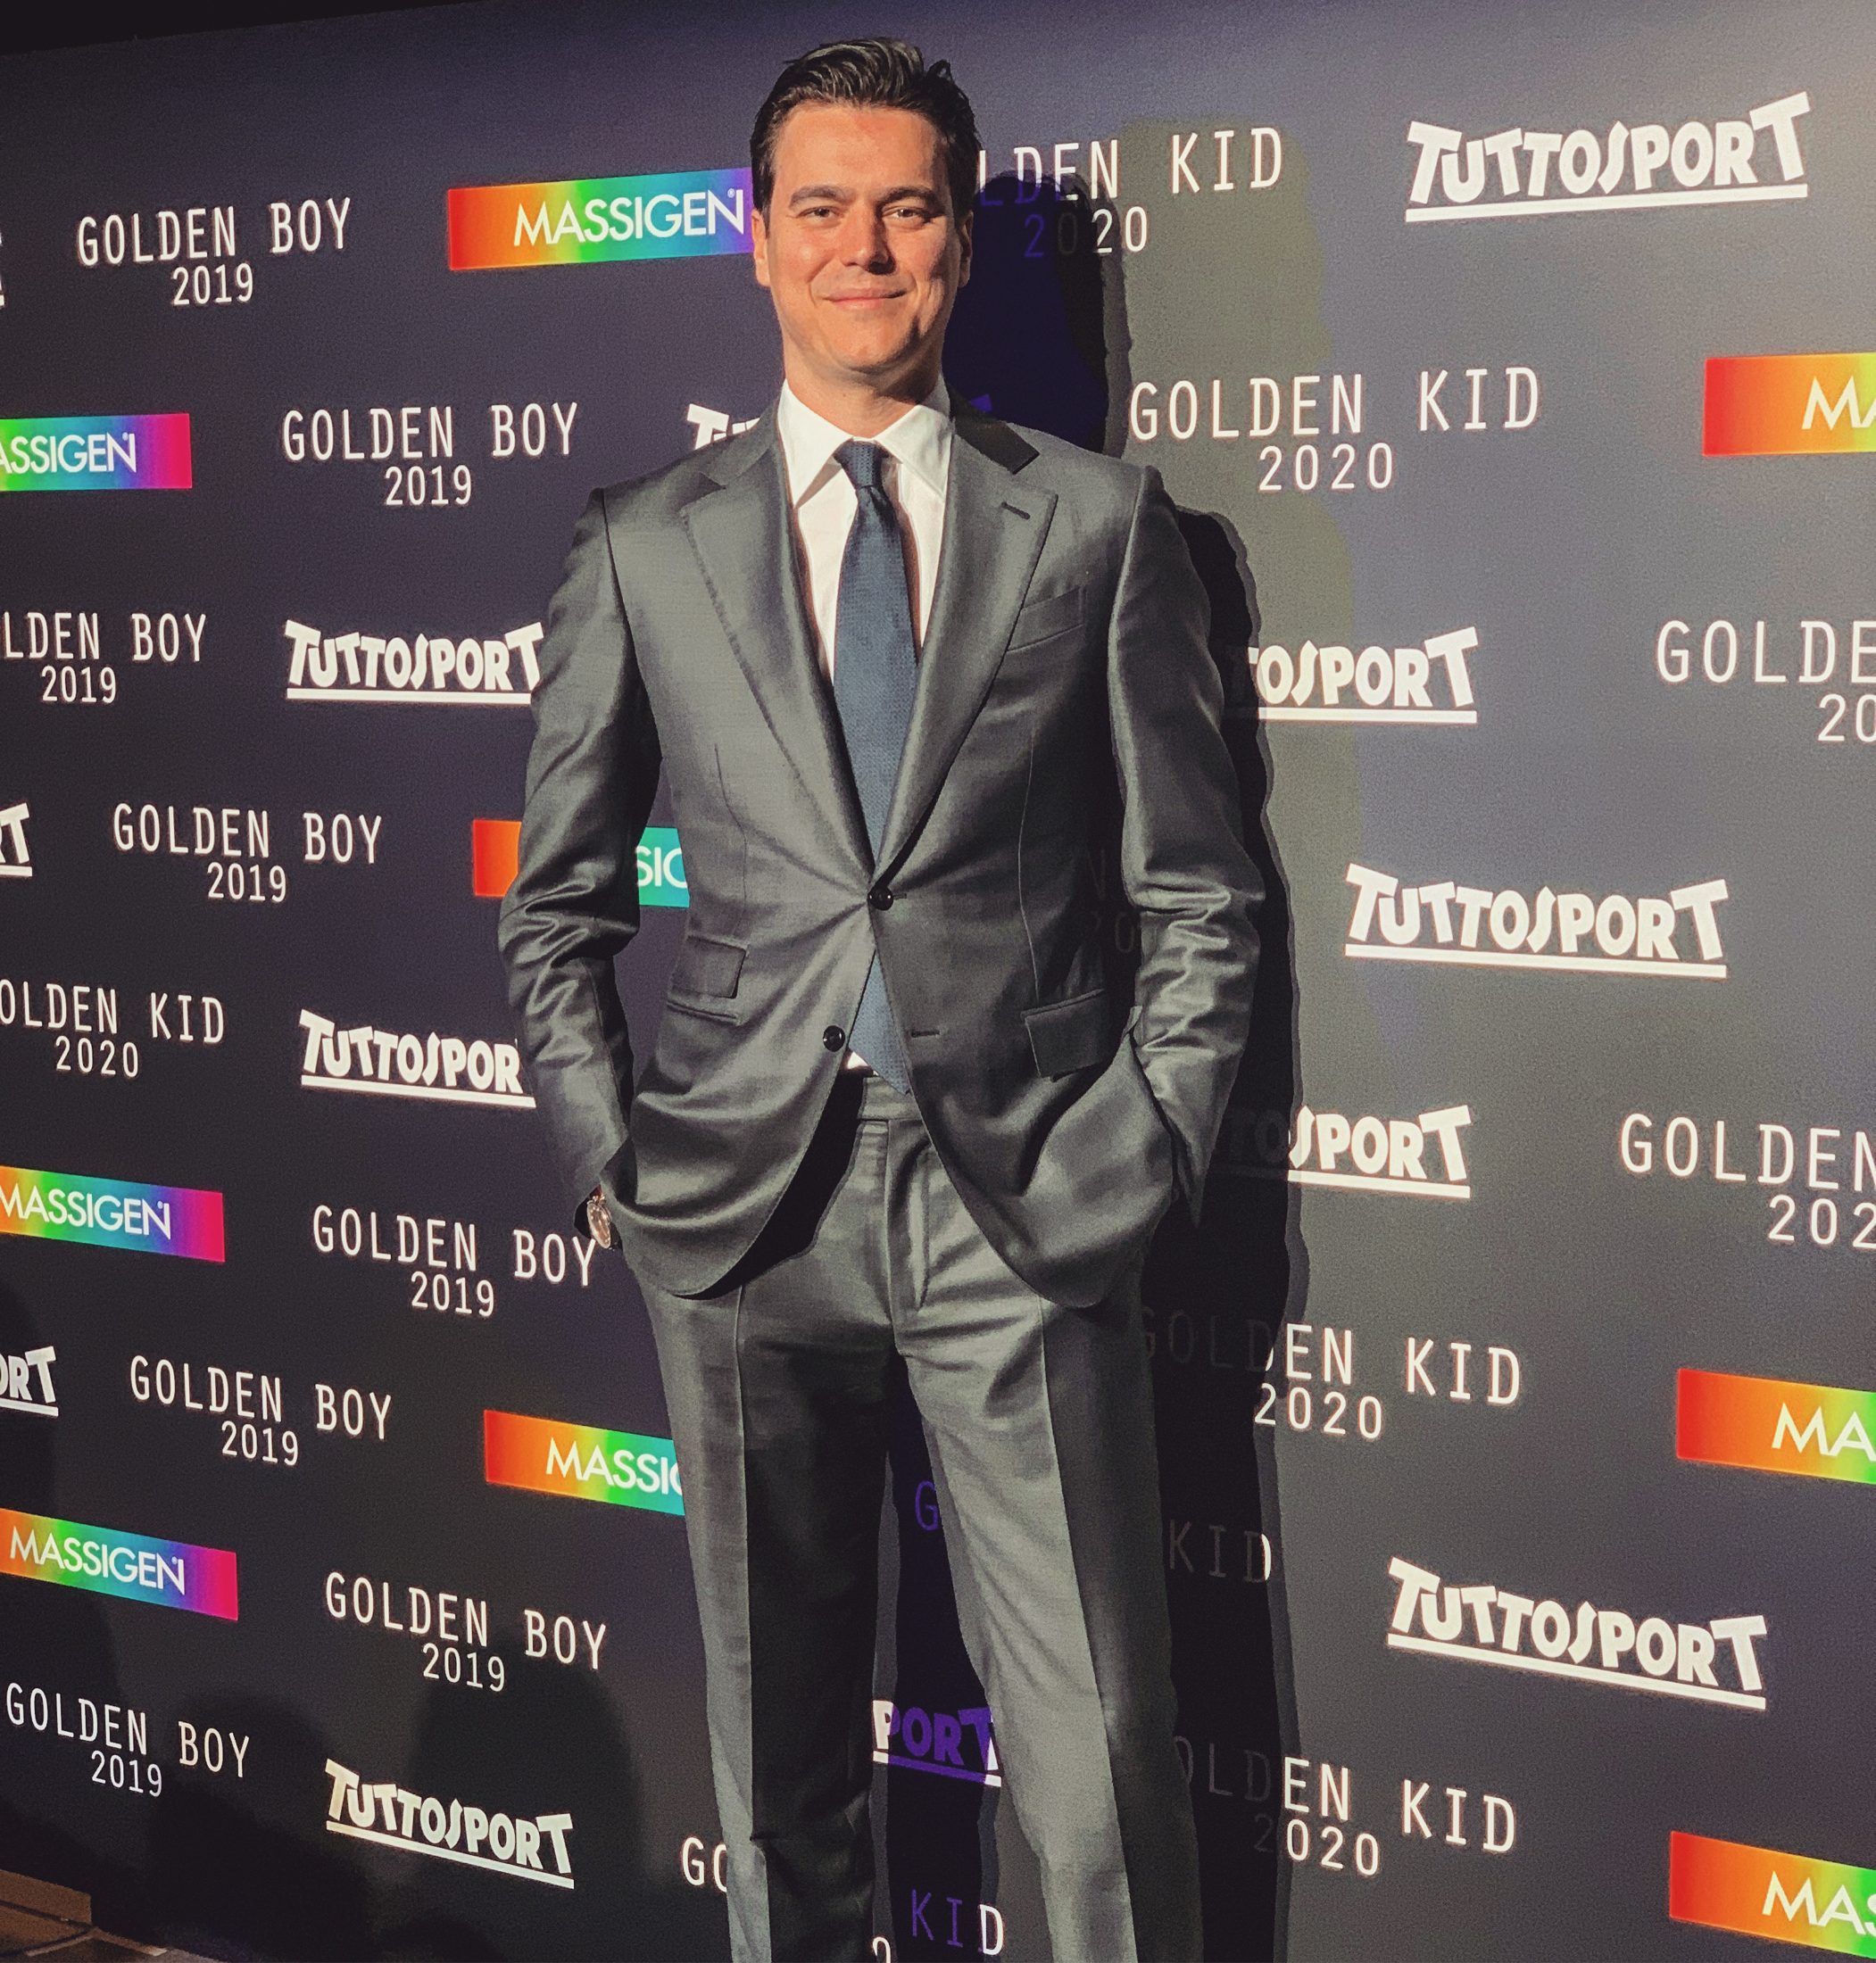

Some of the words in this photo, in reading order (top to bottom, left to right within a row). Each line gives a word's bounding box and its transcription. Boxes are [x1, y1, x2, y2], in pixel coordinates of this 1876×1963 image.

[1173, 128, 1281, 193] KID
[1407, 92, 1810, 204] TUTTOSPORT
[79, 206, 235, 265] GOLDEN
[271, 197, 350, 253] BOY
[515, 188, 743, 245] MASSIGEN
[173, 263, 253, 304] 2019
[284, 407, 452, 460] GOLDEN
[492, 402, 577, 456] BOY
[1131, 374, 1361, 440] GOLDEN
[1421, 368, 1538, 431] KID
[386, 465, 470, 505] 2019
[1260, 443, 1391, 490] 2020
[132, 614, 205, 661] BOY
[285, 620, 544, 690] TUTTOSPORT
[1249, 626, 1478, 707] OSPORT
[42, 666, 115, 703] 2019
[114, 804, 269, 857] GOLDEN
[303, 813, 381, 863] BOY
[208, 863, 286, 902] 2019
[1346, 864, 1728, 960] TUTTOSPORT
[0, 980, 117, 1033] OLDEN
[151, 993, 223, 1043] KID
[56, 1036, 137, 1077] 2020
[300, 1009, 523, 1094] TUTTOSPOR
[314, 1205, 476, 1271] GOLDEN
[513, 1230, 595, 1286] BOY
[411, 1271, 494, 1316] 2019
[131, 1355, 281, 1421] GOLDEN
[316, 1384, 391, 1439] BOY
[1408, 1338, 1519, 1404] KID
[222, 1421, 297, 1465] 2019
[1255, 1383, 1382, 1438] 2020
[10, 1527, 185, 1594] MASSIGEN
[327, 1572, 486, 1646] GOLDEN
[525, 1610, 605, 1669] BOY
[1388, 1557, 1767, 1690] TUTTOSPORT
[423, 1644, 504, 1691] 2019
[7, 1683, 146, 1755] GOLDEN
[178, 1721, 249, 1777] BOY
[92, 1751, 162, 1796] 2019
[326, 1759, 573, 1874] TUTTOSPORT
[1404, 1780, 1514, 1851] KID
[910, 1889, 1004, 1956] KID
